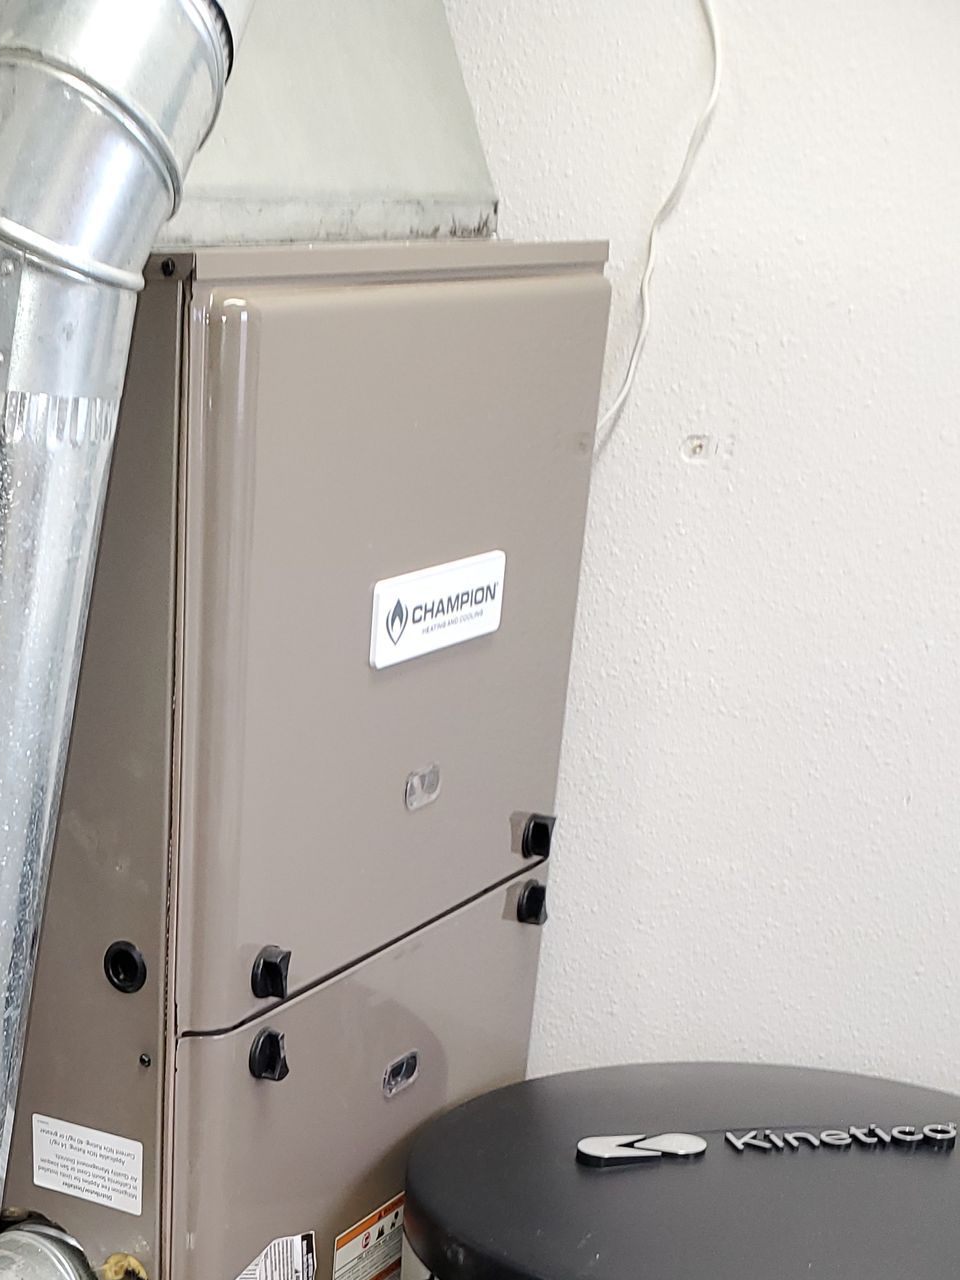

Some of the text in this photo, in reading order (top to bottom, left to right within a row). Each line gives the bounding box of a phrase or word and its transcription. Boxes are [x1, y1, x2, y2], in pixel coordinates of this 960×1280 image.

[412, 582, 497, 624] CHAMPION
[422, 622, 446, 634] HEATING
[447, 617, 459, 626] AND
[725, 1123, 958, 1151] Kinetico
[107, 1177, 132, 1190] California
[111, 1186, 138, 1200] Mitigation
